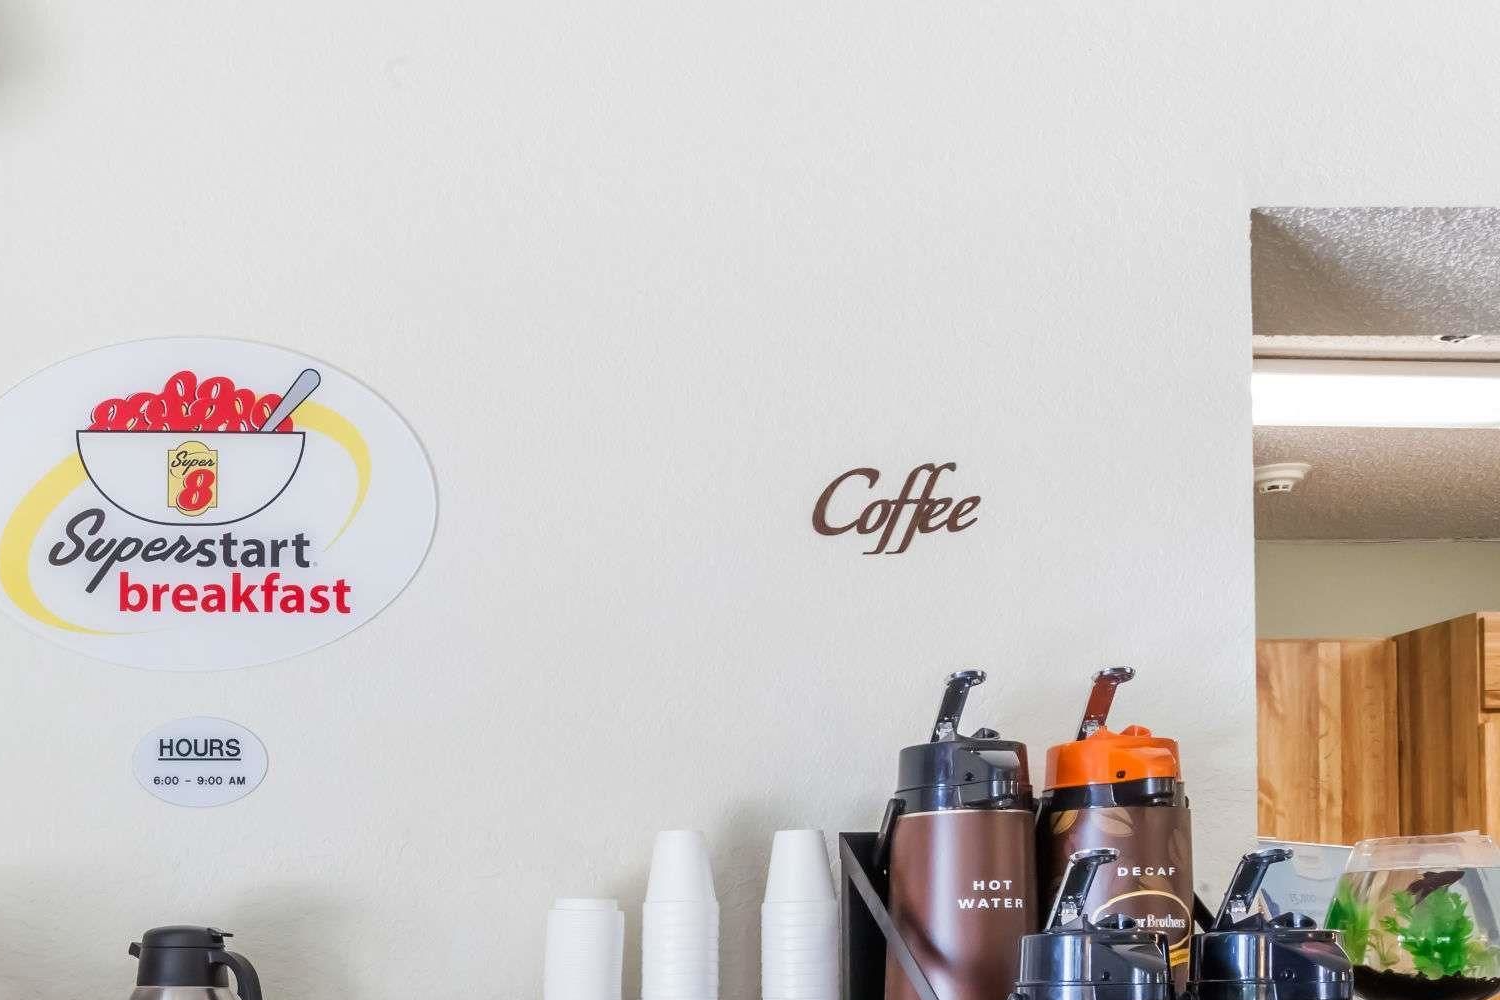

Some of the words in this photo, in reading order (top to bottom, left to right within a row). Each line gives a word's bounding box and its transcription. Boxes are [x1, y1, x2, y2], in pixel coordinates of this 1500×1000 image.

[170, 450, 218, 478] Super
[175, 468, 217, 512] 8
[811, 461, 982, 555] Coffee
[117, 571, 353, 614] breakfast
[159, 738, 241, 758] HOURS
[153, 776, 179, 786] 6:00
[197, 776, 223, 786] 9:00
[228, 776, 246, 786] AM
[1117, 866, 1177, 877] DECAF
[971, 879, 1013, 891] HOT
[957, 898, 1024, 909] WATER
[1147, 914, 1186, 929] Brothers
